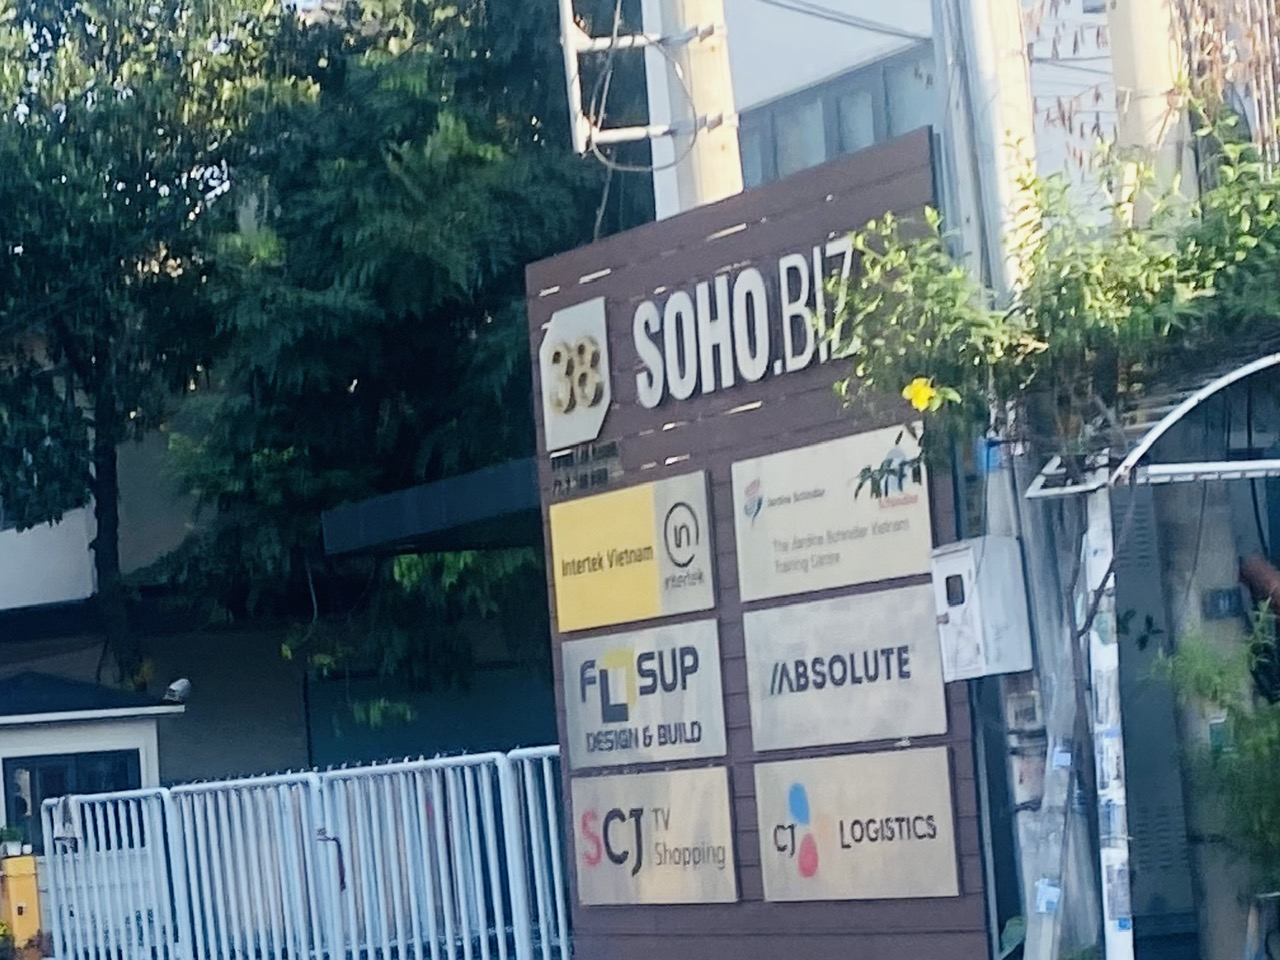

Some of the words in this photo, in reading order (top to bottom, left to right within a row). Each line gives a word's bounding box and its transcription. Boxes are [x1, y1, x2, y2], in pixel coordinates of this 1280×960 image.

[633, 231, 862, 409] SOHO.BIZ
[550, 334, 604, 414] 38
[562, 553, 604, 577] Intertek
[607, 546, 654, 568] Vietnam
[586, 728, 639, 752] DESIGN
[643, 726, 653, 748] &
[658, 721, 702, 746] BUILD
[582, 808, 643, 877] SCJ
[652, 808, 670, 831] TV
[655, 842, 726, 870] Shopping
[774, 823, 797, 858] CJ
[839, 815, 937, 849] LOGISTICS
